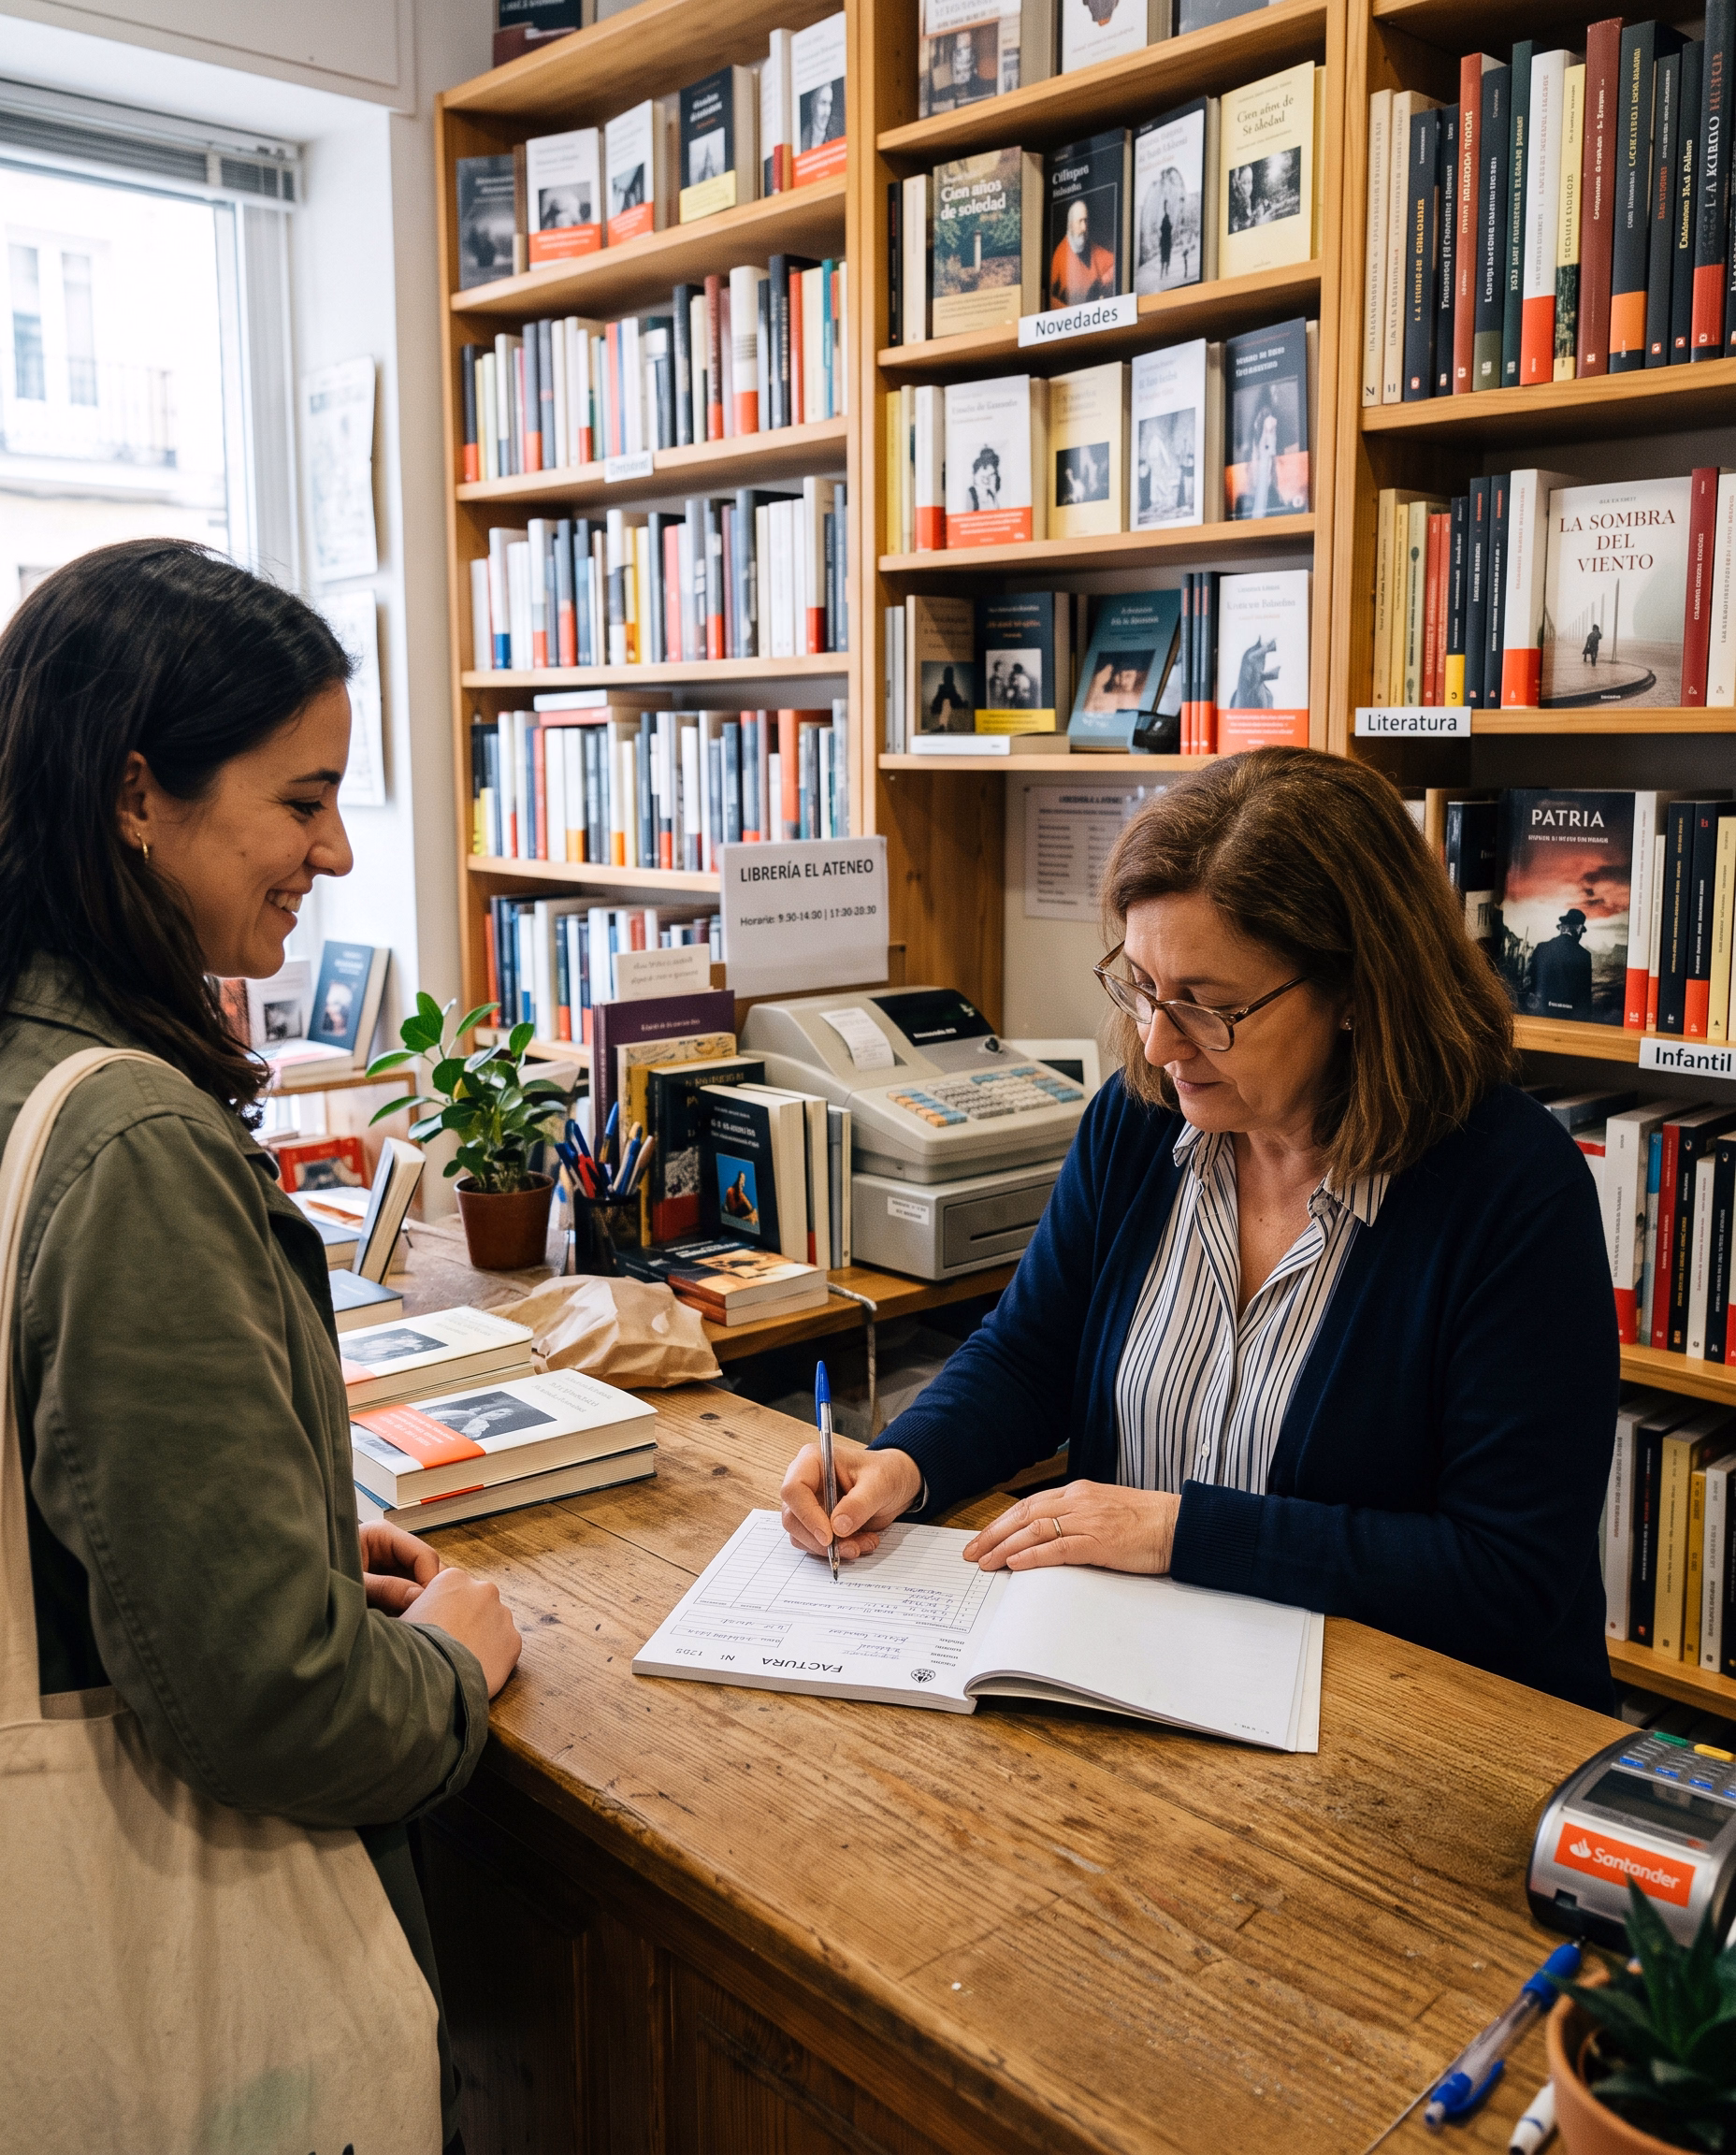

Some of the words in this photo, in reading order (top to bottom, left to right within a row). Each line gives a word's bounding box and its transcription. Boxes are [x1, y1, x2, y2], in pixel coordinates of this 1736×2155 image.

[940, 186, 970, 203] Cien
[972, 179, 1003, 197] años
[940, 205, 956, 221] de
[959, 193, 1006, 217] soledad
[1035, 305, 1118, 338] Novedades
[1558, 516, 1586, 534] LA
[1588, 509, 1676, 531] SOMBRA
[1596, 534, 1636, 551] DEL
[1576, 554, 1655, 573] VIENTO
[1367, 714, 1457, 731] Literatura
[1531, 809, 1605, 828] PATRIA
[741, 861, 801, 882] LIBRERÍA
[804, 863, 819, 877] EL
[822, 859, 874, 876] ATENEO
[1655, 1047, 1731, 1073] Infantil
[761, 1656, 844, 1674] FACTURA
[1592, 1846, 1681, 1889] Santander
